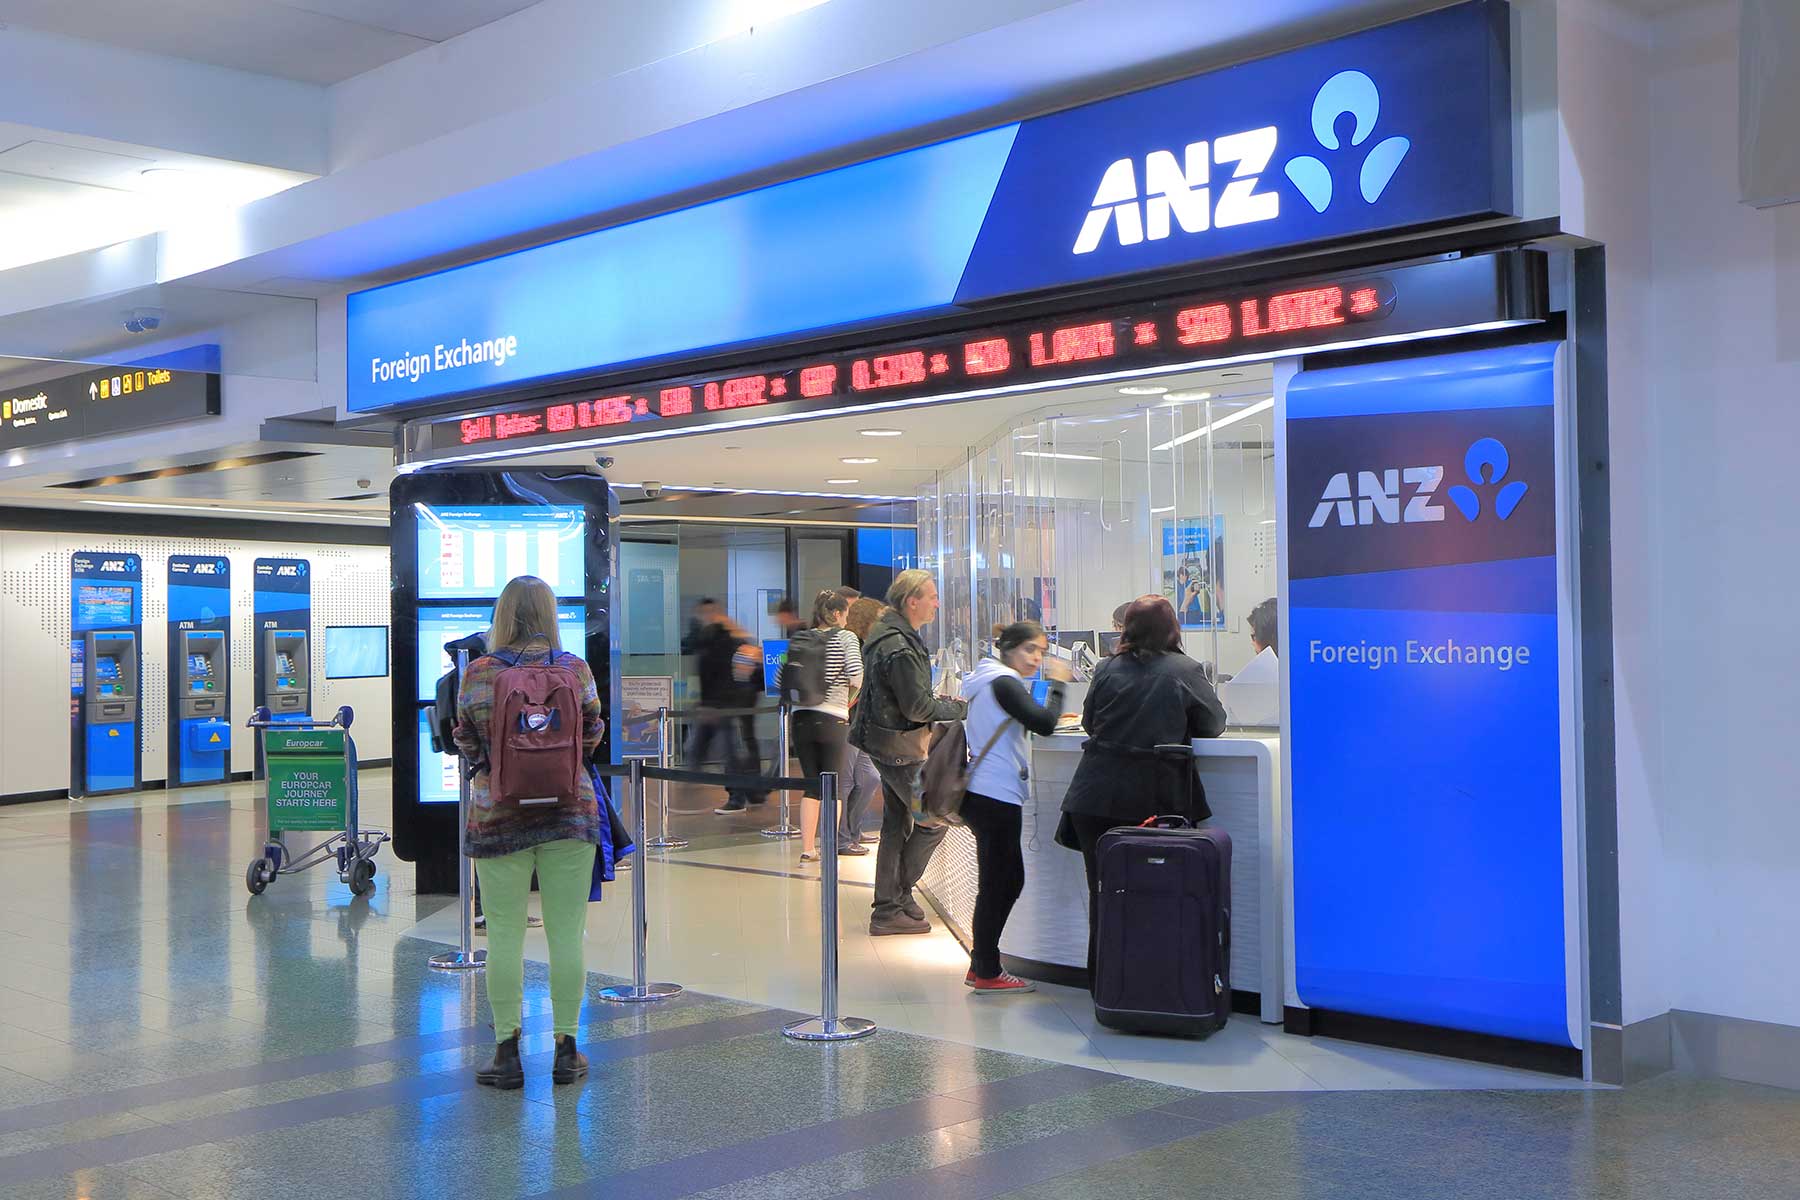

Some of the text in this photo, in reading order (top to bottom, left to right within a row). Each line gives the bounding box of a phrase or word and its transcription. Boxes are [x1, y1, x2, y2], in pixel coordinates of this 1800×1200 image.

[1073, 126, 1280, 255] ANZ
[371, 335, 518, 384] Foreign Exchange
[147, 369, 171, 386] Toilets
[12, 391, 48, 415] Domestic
[1308, 465, 1446, 528] ANZ
[100, 560, 126, 572] ANZ
[193, 563, 215, 574] ANZ
[276, 566, 297, 576] ANZ
[178, 621, 194, 630] ATM
[263, 621, 278, 629] ATM
[1309, 638, 1530, 671] Foreign Exchange
[285, 739, 324, 748] Europcar
[293, 772, 319, 780] YOUR
[281, 781, 332, 789] EUROPCAR
[284, 790, 328, 798] JOURNEY
[275, 799, 337, 807] STARTS HERE
